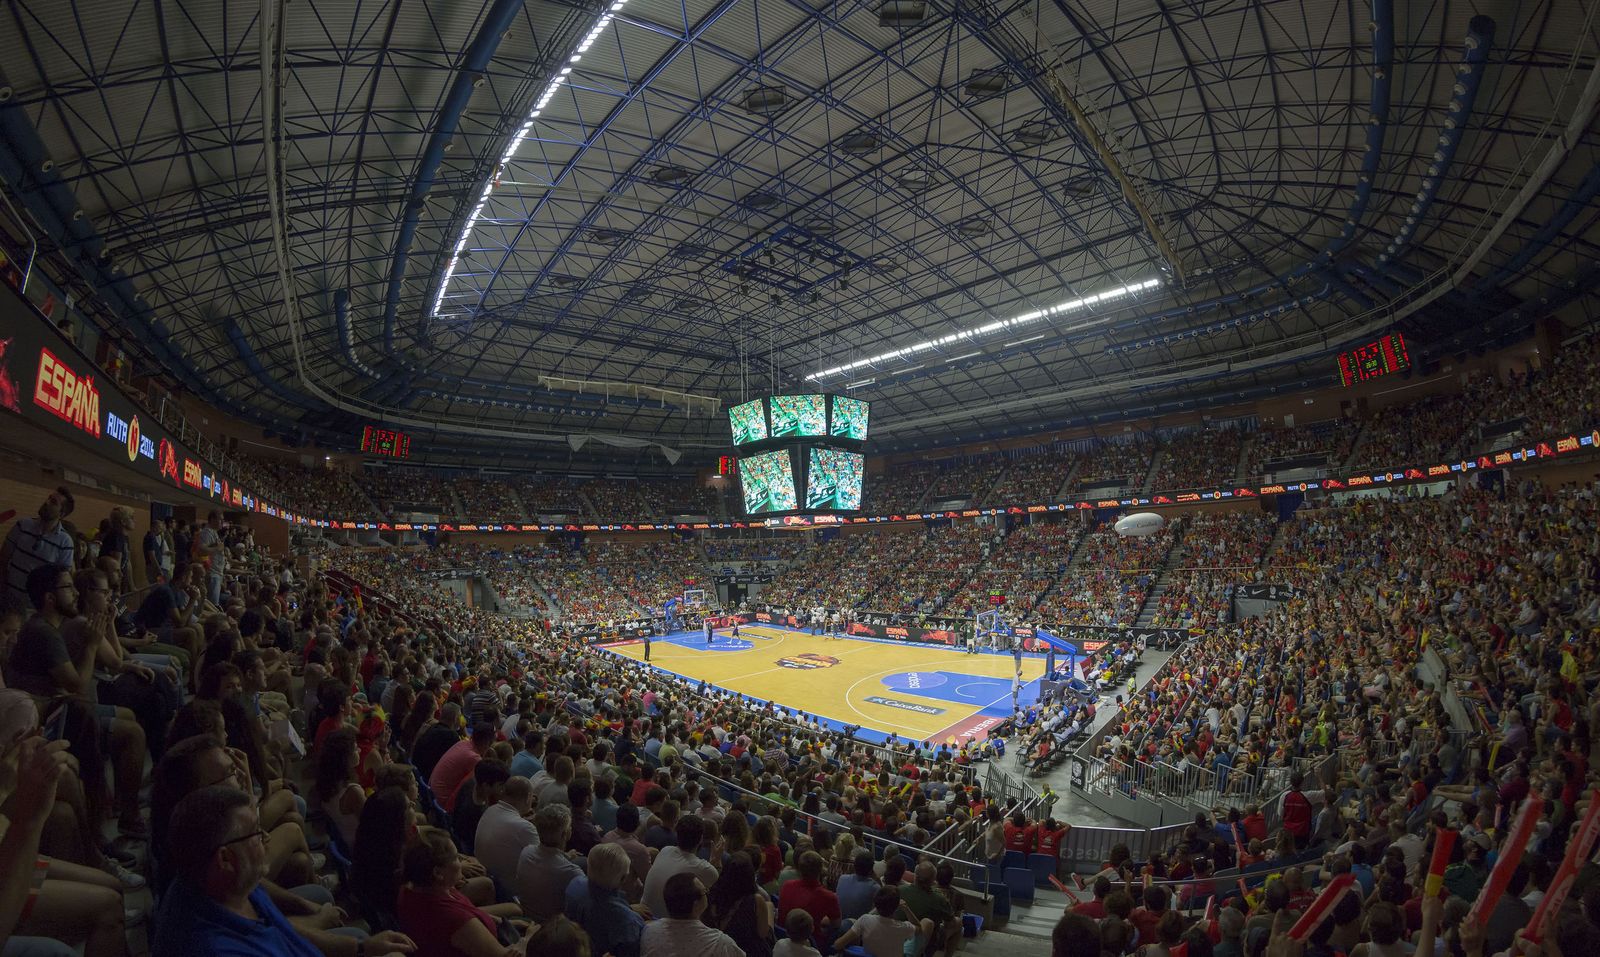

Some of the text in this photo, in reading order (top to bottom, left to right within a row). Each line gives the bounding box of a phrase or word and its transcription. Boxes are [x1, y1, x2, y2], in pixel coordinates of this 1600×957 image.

[34, 348, 101, 438] ESPAÑA
[106, 411, 128, 444] RUTA
[138, 434, 155, 460] 2016
[1348, 475, 1373, 486] ESPAÑA
[1260, 485, 1286, 495] ESPAÑA
[1084, 641, 1108, 650] ESPA
[885, 700, 938, 714] CaixaBank
[960, 718, 999, 738] IBERIA
